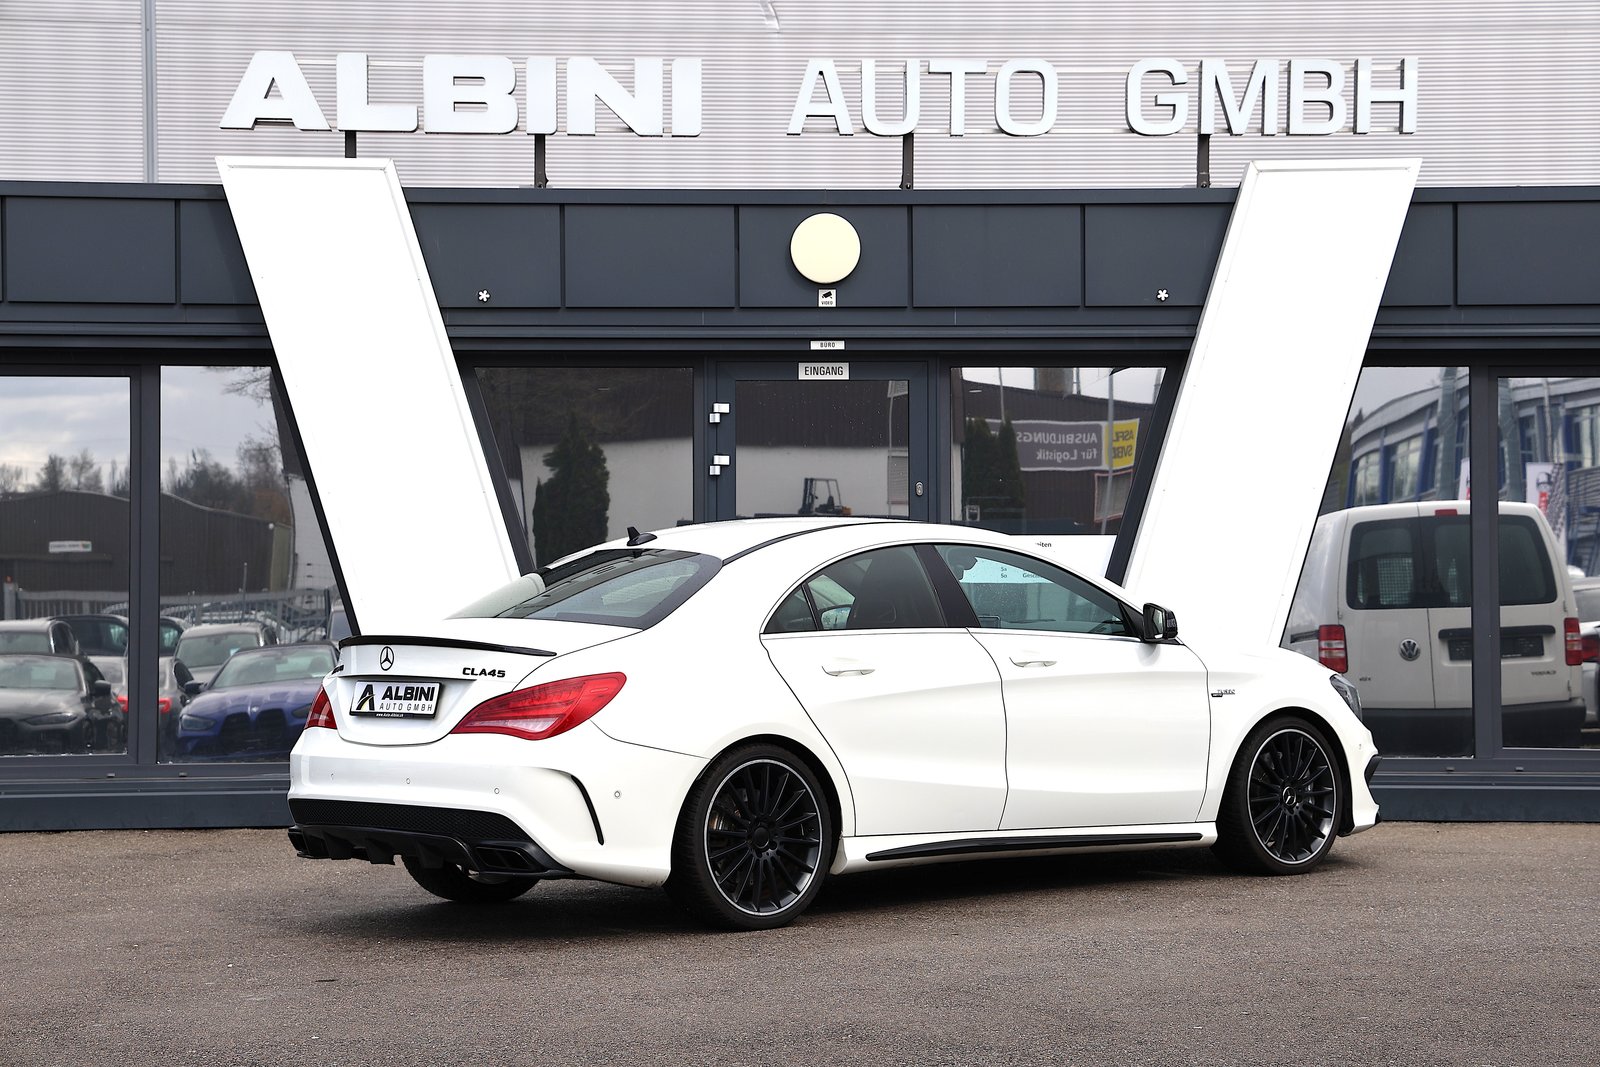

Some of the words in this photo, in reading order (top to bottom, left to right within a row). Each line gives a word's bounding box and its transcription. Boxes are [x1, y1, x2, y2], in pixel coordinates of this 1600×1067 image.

[219, 50, 703, 137] ALBINI
[786, 57, 1059, 136] AUTO
[1125, 56, 1419, 136] GMBH
[804, 366, 844, 376] EINGANG
[462, 667, 506, 678] CLA45
[382, 686, 435, 702] ALBINI
[379, 702, 403, 711] AUTO
[406, 703, 433, 712] GMBH
